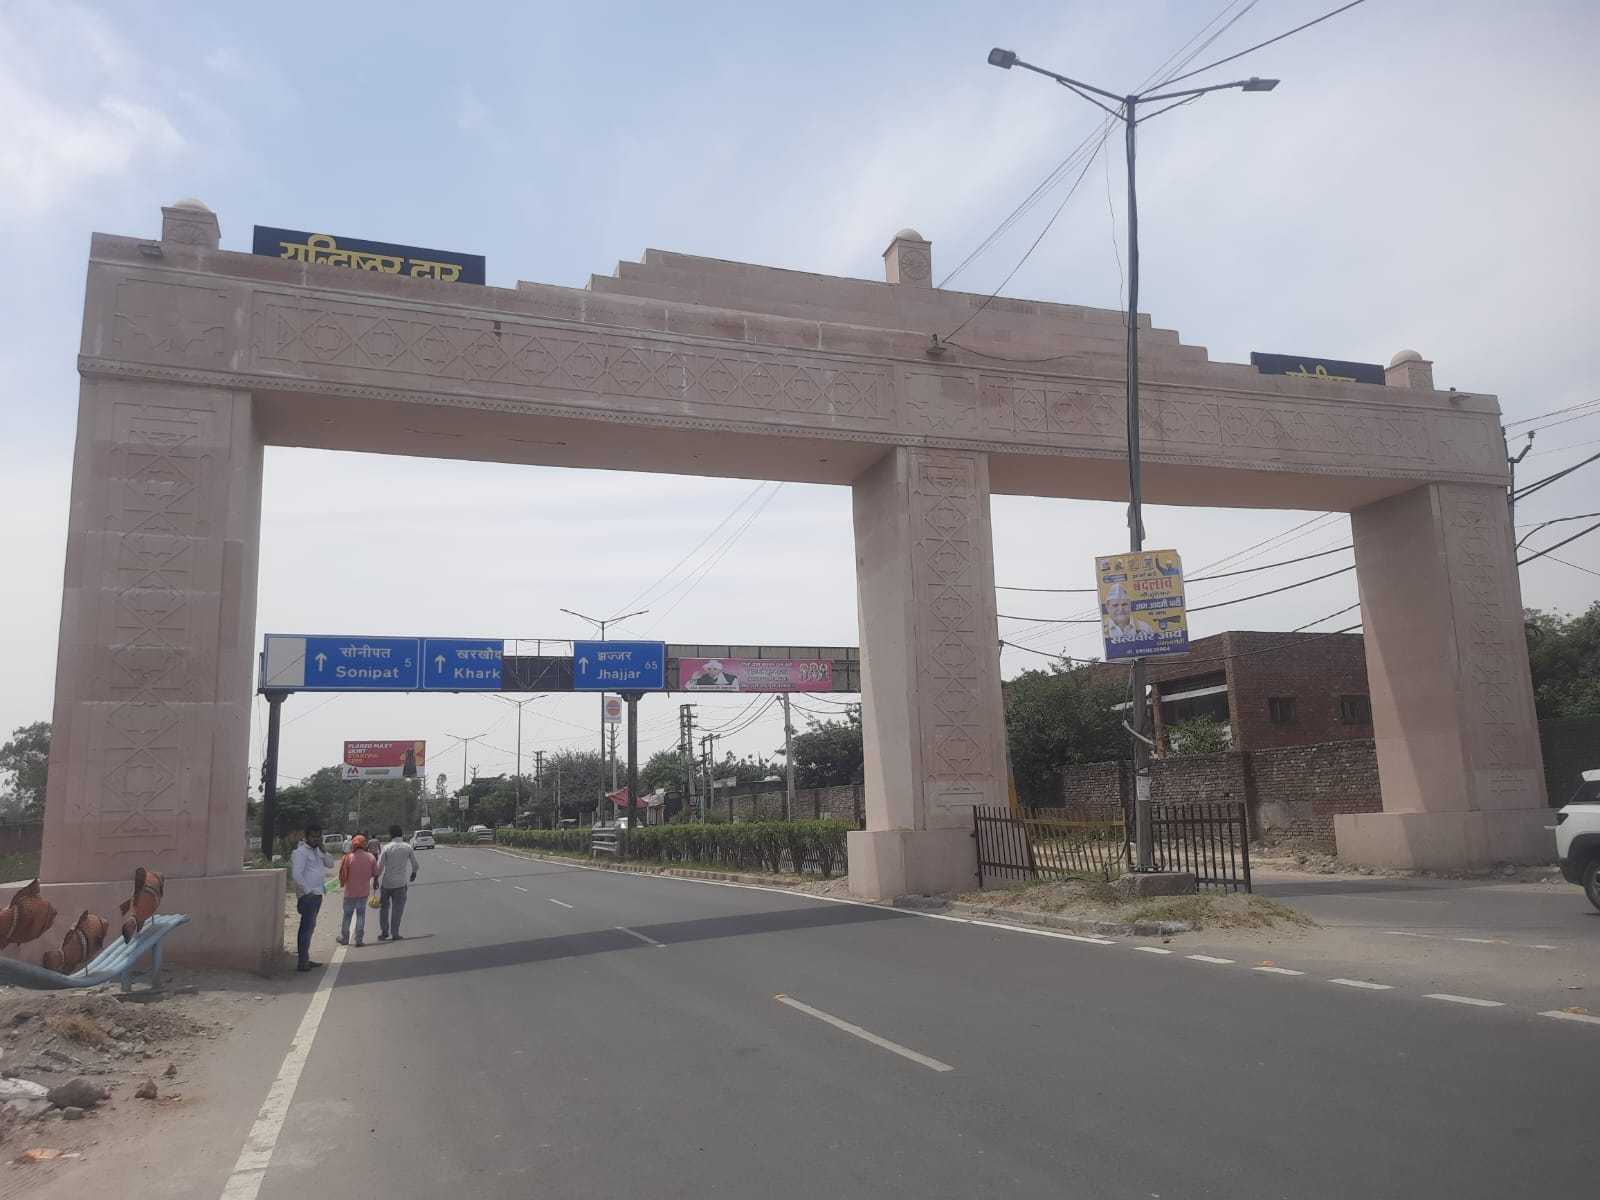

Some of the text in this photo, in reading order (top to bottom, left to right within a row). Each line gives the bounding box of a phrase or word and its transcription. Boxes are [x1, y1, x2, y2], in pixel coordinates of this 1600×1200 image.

[1133, 577, 1173, 591] बदलाव
[1149, 599, 1168, 609] आदमी
[1110, 631, 1155, 644] सत्यवीर
[339, 644, 392, 659] सोनीपत
[596, 651, 632, 661] झज्जर
[404, 658, 412, 668] 5
[644, 660, 658, 670] 65
[336, 666, 399, 680] Sonipat
[454, 667, 502, 679] Khark
[596, 668, 641, 682] Jhajjar
